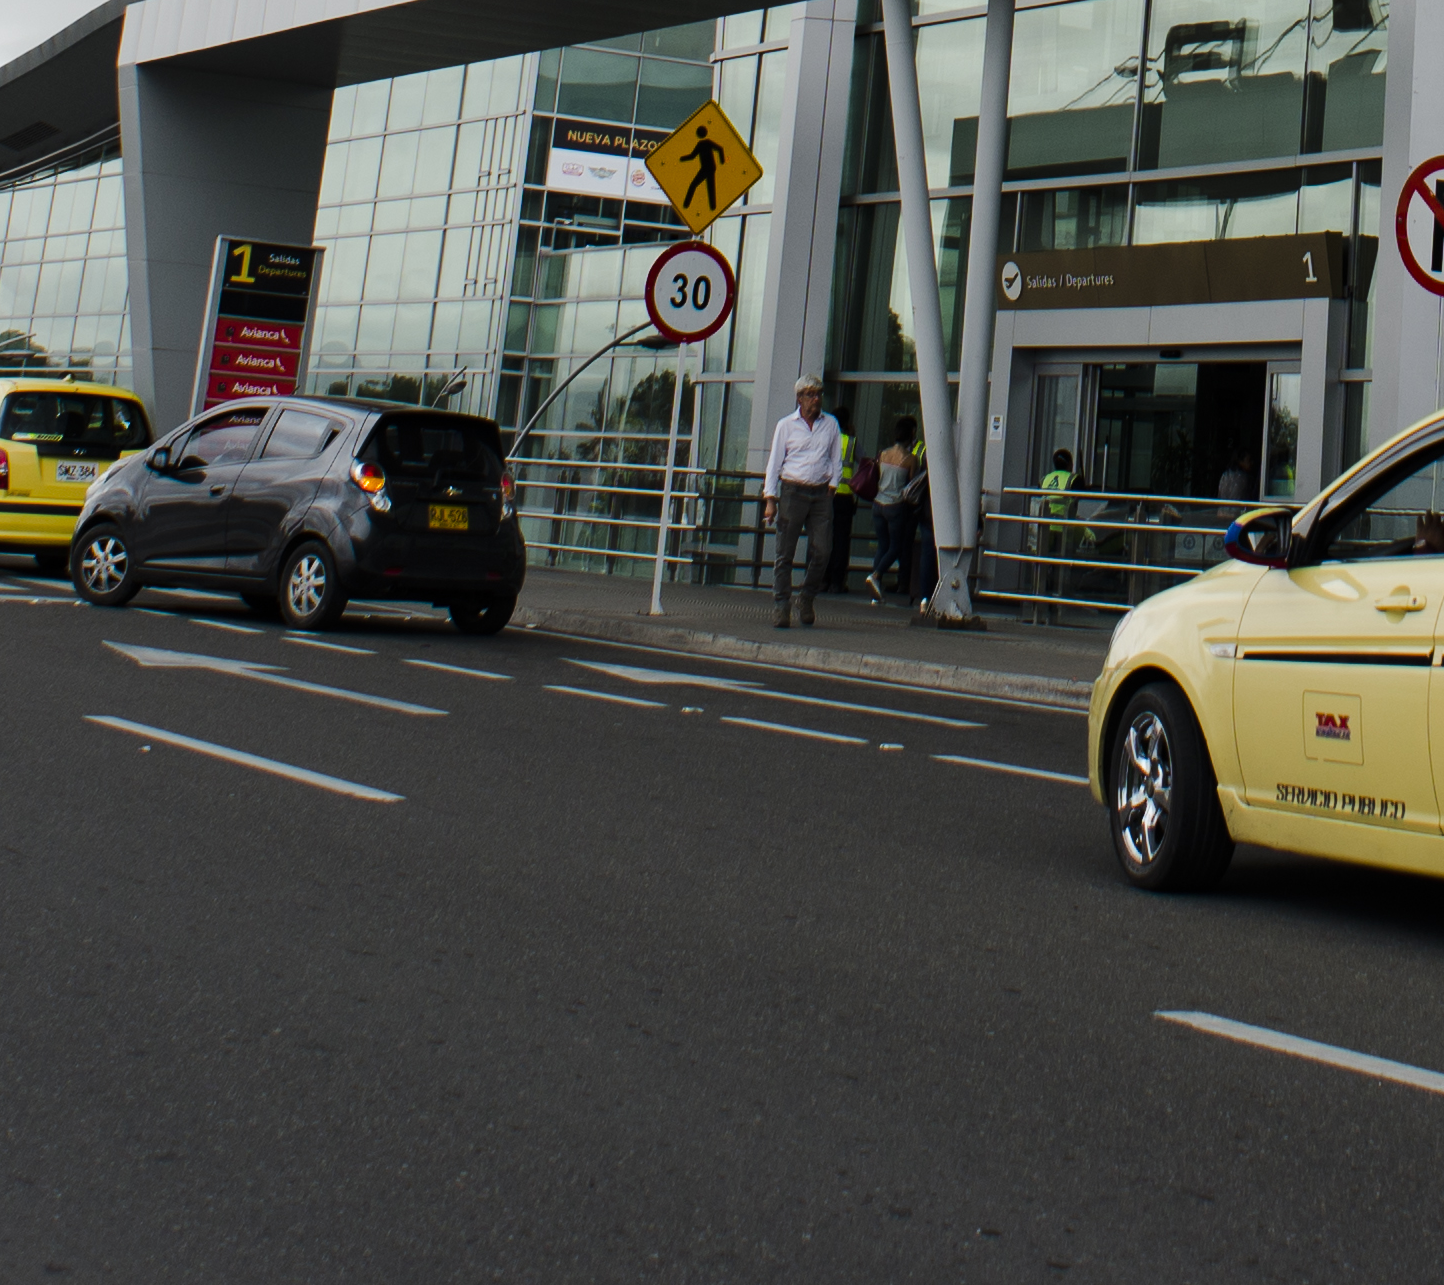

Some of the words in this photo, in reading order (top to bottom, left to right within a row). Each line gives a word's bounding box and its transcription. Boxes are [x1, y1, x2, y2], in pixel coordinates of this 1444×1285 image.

[567, 130, 611, 146] NUEVA
[614, 136, 662, 151] PLAZO
[230, 243, 255, 283] 1
[269, 253, 301, 265] Salidas
[1303, 251, 1317, 282] 1
[258, 265, 307, 278] Departures
[1027, 276, 1056, 289] Salidas
[1066, 274, 1114, 290] Departures
[670, 274, 712, 312] 30
[240, 326, 279, 340] Avianca
[236, 354, 274, 368] Avianca
[232, 382, 271, 396] Avianca
[229, 415, 262, 424] Avianc
[1316, 712, 1349, 729] TAX
[1276, 783, 1338, 810] SERVICIO
[1342, 793, 1406, 820] PUBLICO
